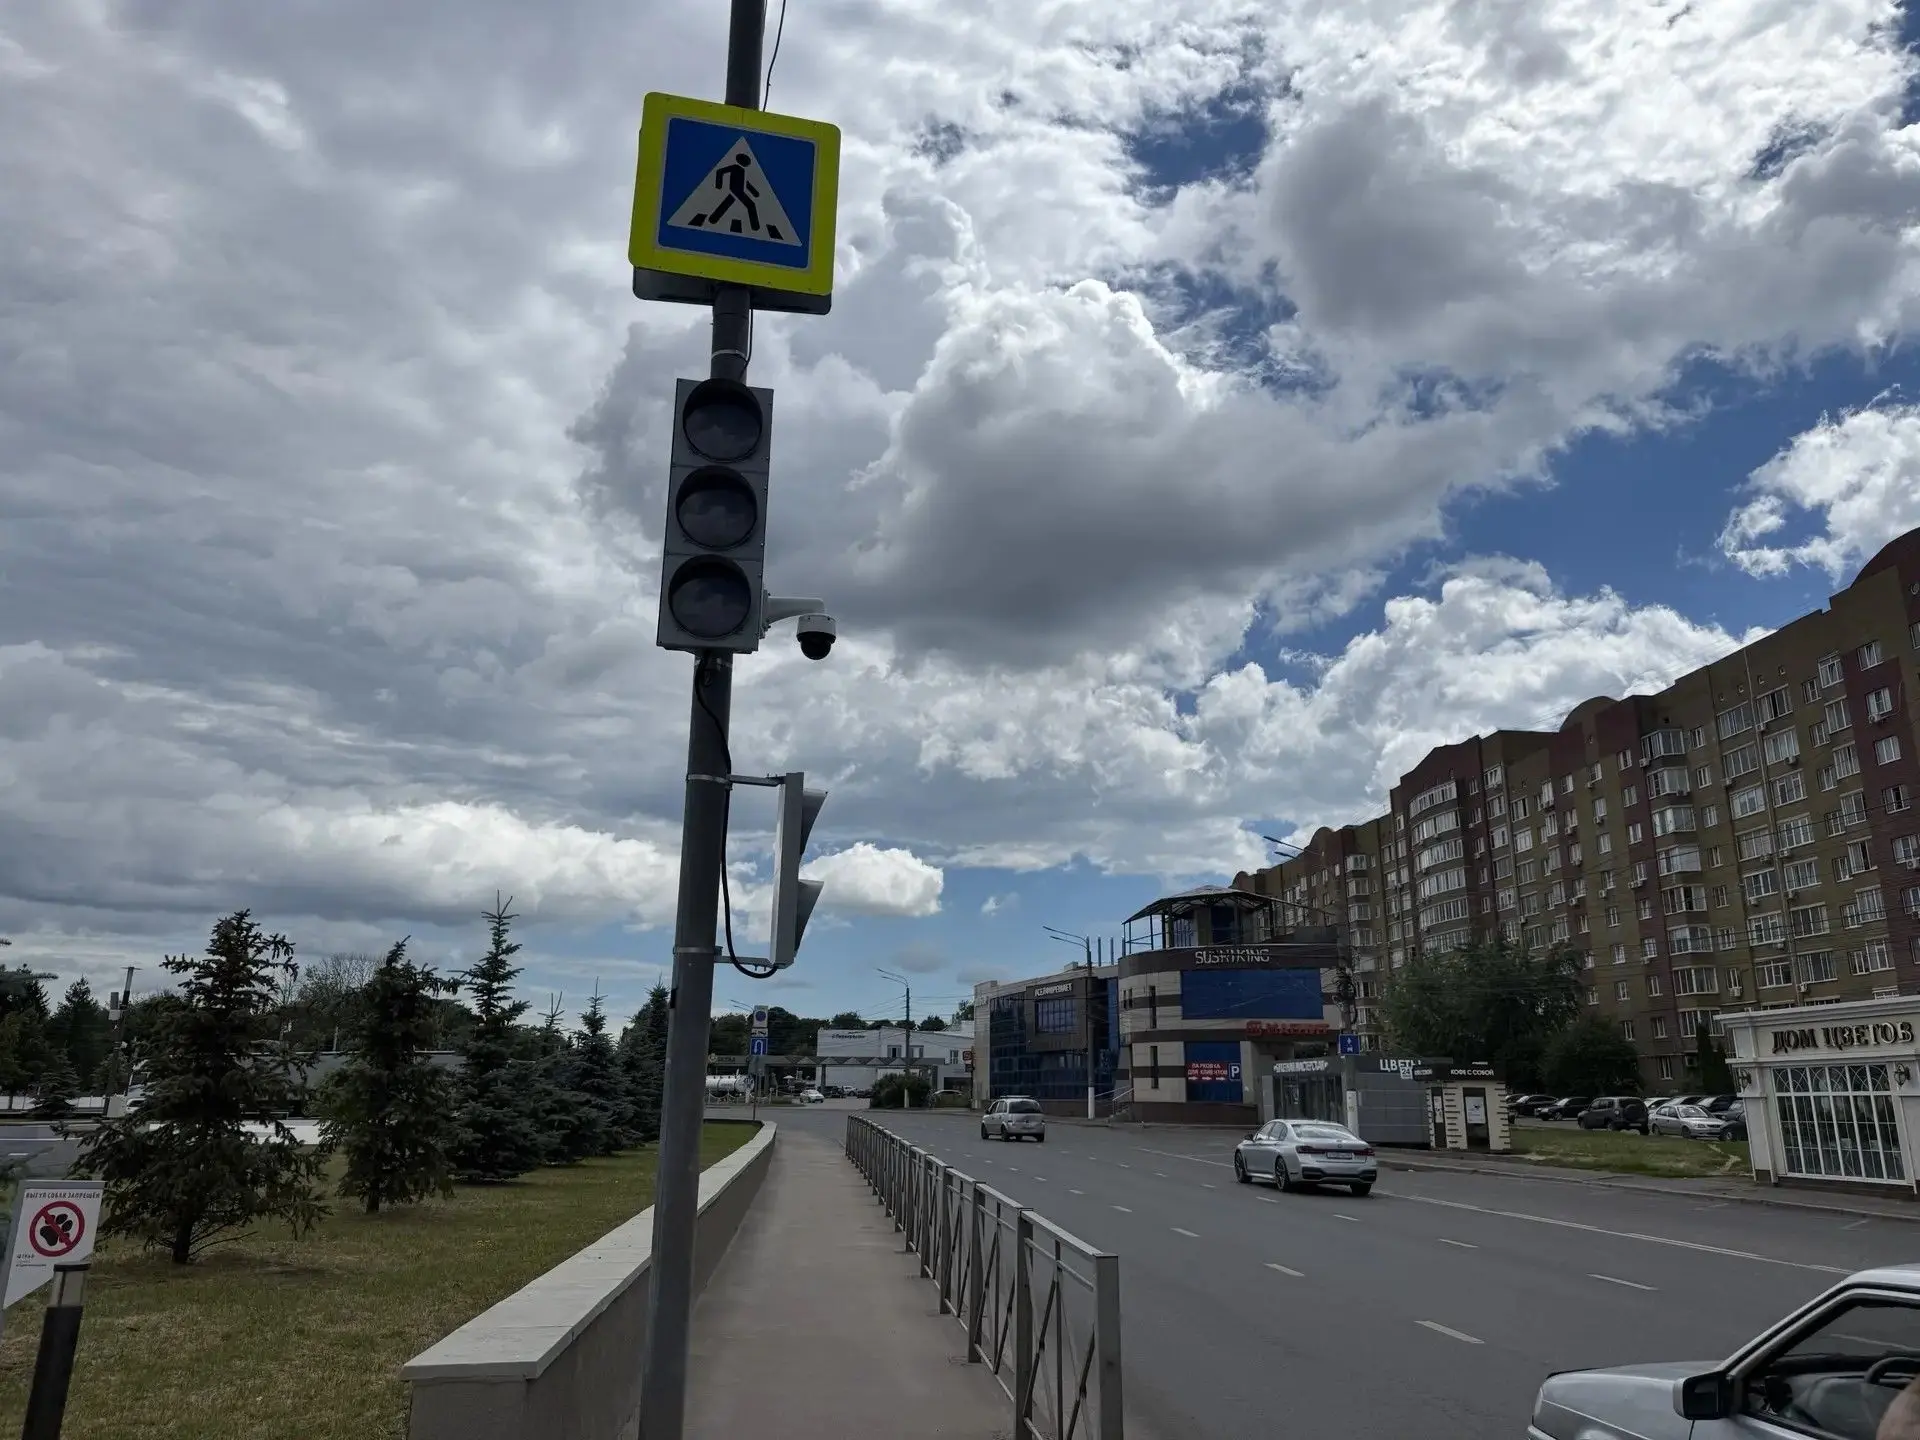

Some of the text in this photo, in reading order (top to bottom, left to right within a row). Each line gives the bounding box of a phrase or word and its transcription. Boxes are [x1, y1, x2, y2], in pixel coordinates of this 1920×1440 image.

[1771, 1022, 1915, 1054] ДОМ ЦВЕТОВ
[1472, 1068, 1495, 1076] СОБОЙ
